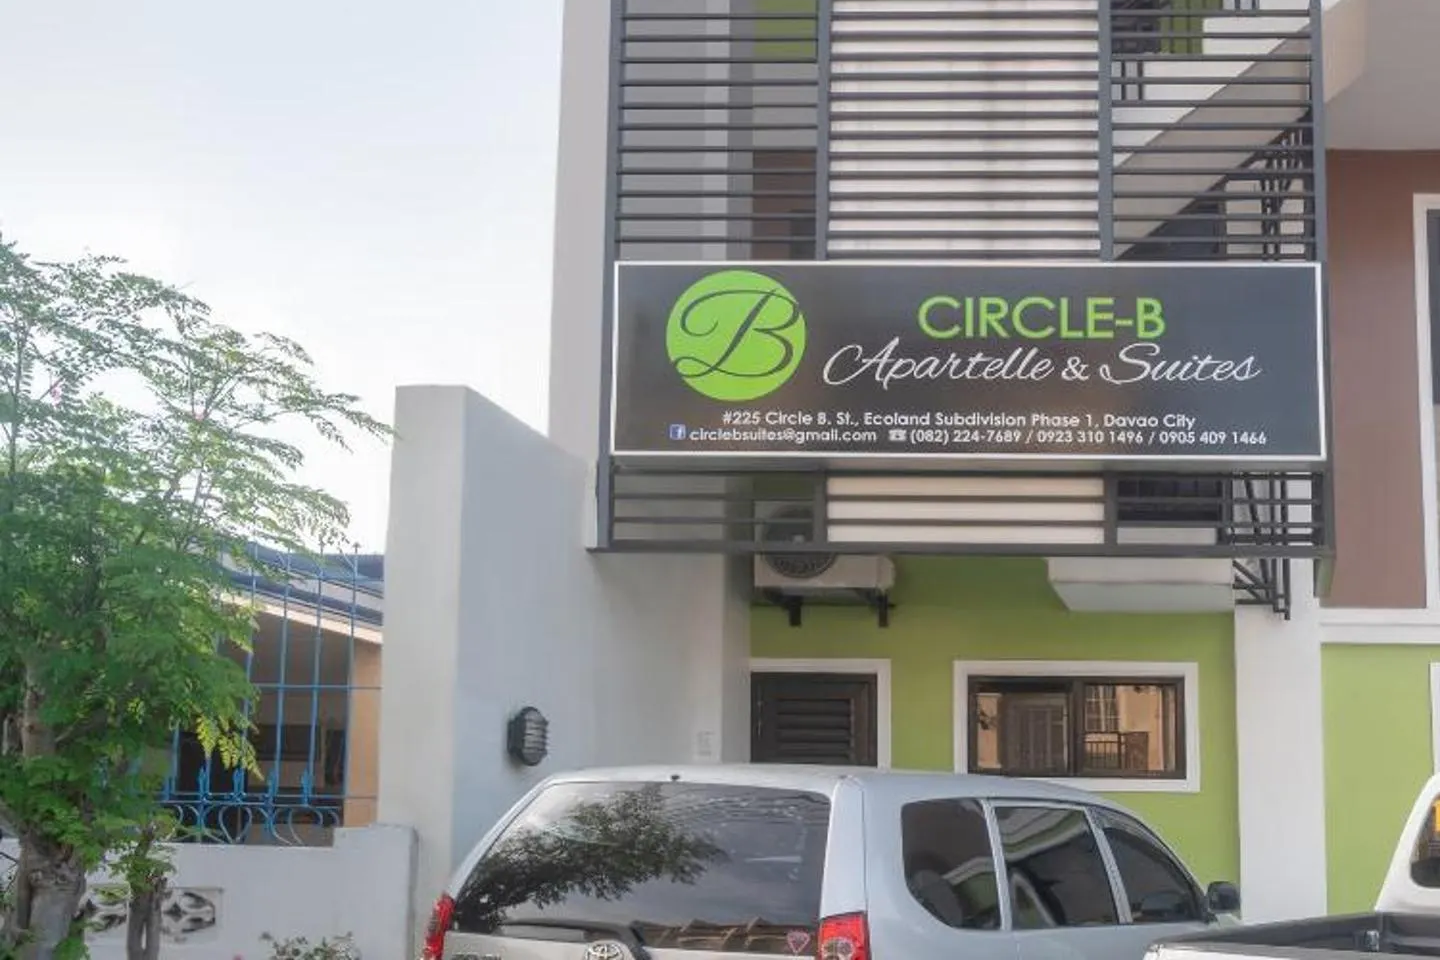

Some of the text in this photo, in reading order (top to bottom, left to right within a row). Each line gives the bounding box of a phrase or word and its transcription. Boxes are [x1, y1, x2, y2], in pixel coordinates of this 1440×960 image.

[918, 295, 1166, 339] CIRCLE-B
[822, 336, 1263, 390] Apartelle & Suites
[689, 426, 877, 443] circlebsuites@gmail.com
[910, 429, 949, 445] (082)
[953, 429, 1022, 443] 224-7689
[1037, 431, 1074, 444] 0923
[1077, 431, 1105, 444] 310
[1109, 431, 1144, 444] 1496
[1158, 431, 1196, 445] 0905
[1199, 431, 1227, 445] 409
[1231, 431, 1268, 445] 1466
[722, 411, 761, 425] #225
[765, 411, 813, 426] Circle
[817, 412, 832, 426] B.
[864, 411, 930, 427] Ecoland
[935, 412, 1026, 427] Subdivision
[1031, 413, 1080, 428] Phase
[1085, 414, 1100, 429] 1,
[1103, 414, 1159, 428] Davao
[1163, 414, 1197, 431] City
